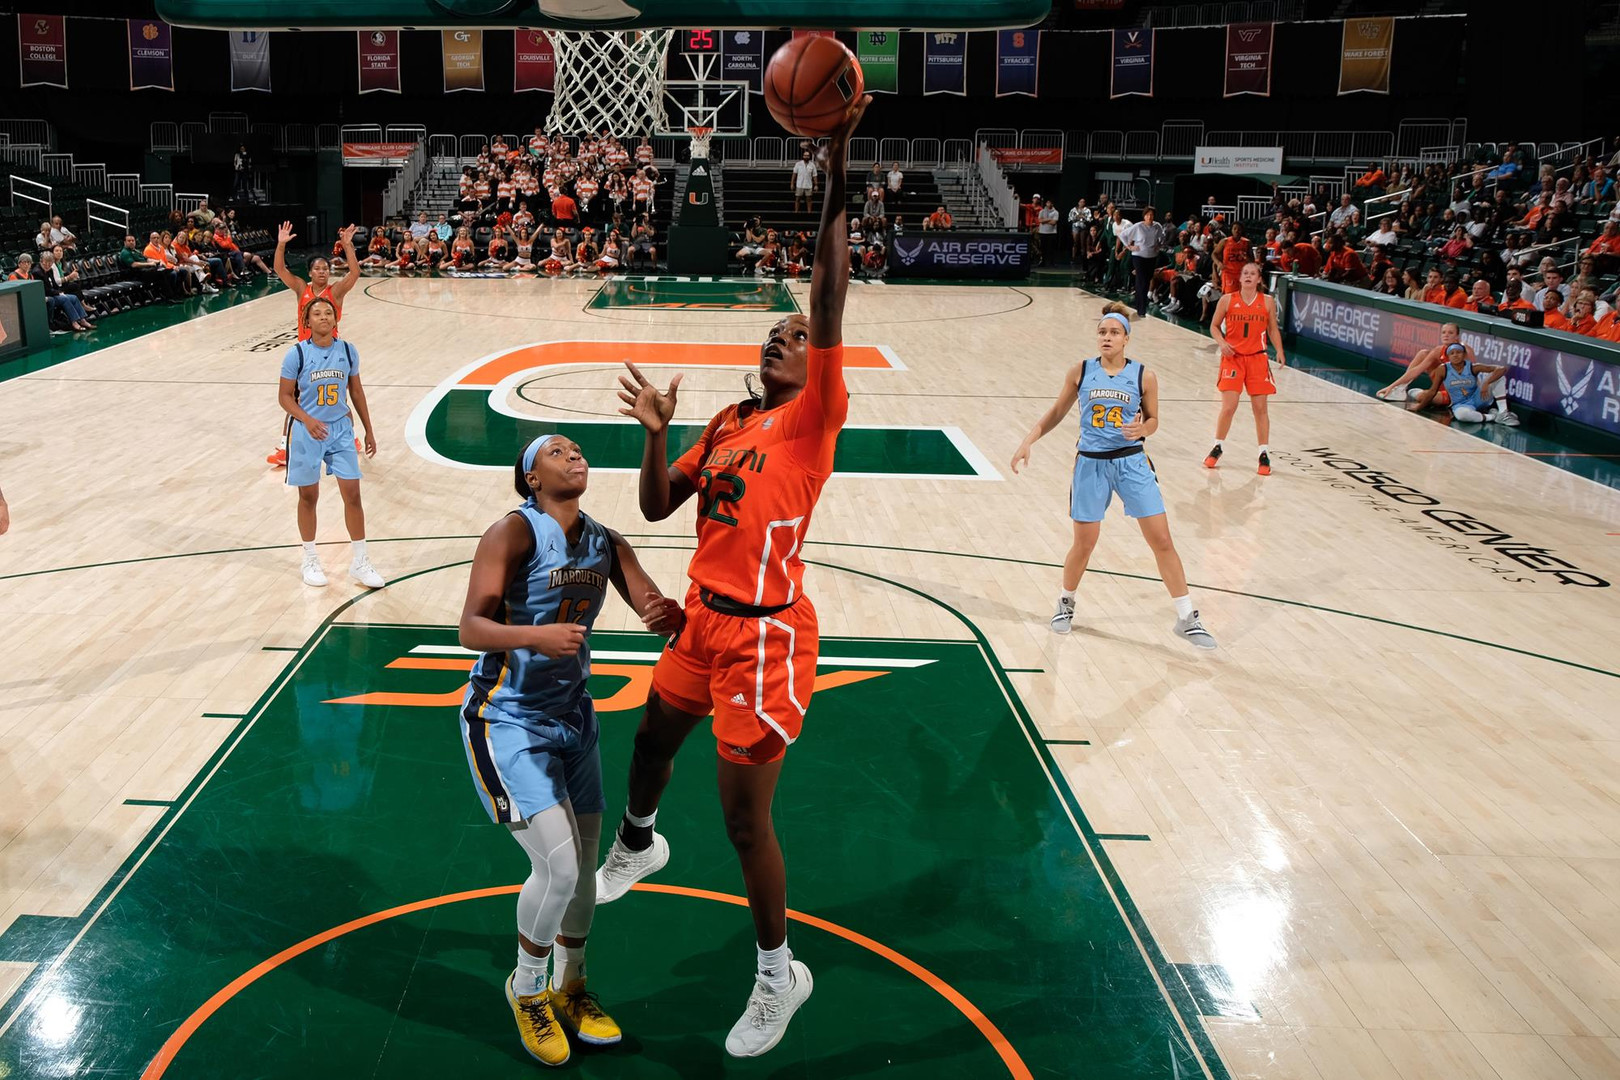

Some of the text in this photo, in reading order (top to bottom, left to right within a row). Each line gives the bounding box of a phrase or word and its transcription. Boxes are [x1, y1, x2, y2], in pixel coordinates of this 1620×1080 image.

[688, 30, 713, 50] 25
[1234, 54, 1262, 62] VIRGINIA
[1364, 49, 1388, 57] FOREST
[688, 191, 709, 206] U
[928, 241, 1029, 254] AIR FORCE
[933, 253, 1022, 266] RESERVE
[1311, 299, 1380, 332] AIR FORCE
[1313, 318, 1375, 350] RESERVE
[310, 369, 345, 382] MARQUETTE
[316, 383, 339, 406] 15
[1089, 388, 1131, 404] MARQUETTE
[1091, 403, 1125, 428] 24
[1269, 450, 1536, 585] COOLING THE AMERICAS
[547, 567, 605, 592] MARQUETTE
[555, 597, 592, 625] 12
